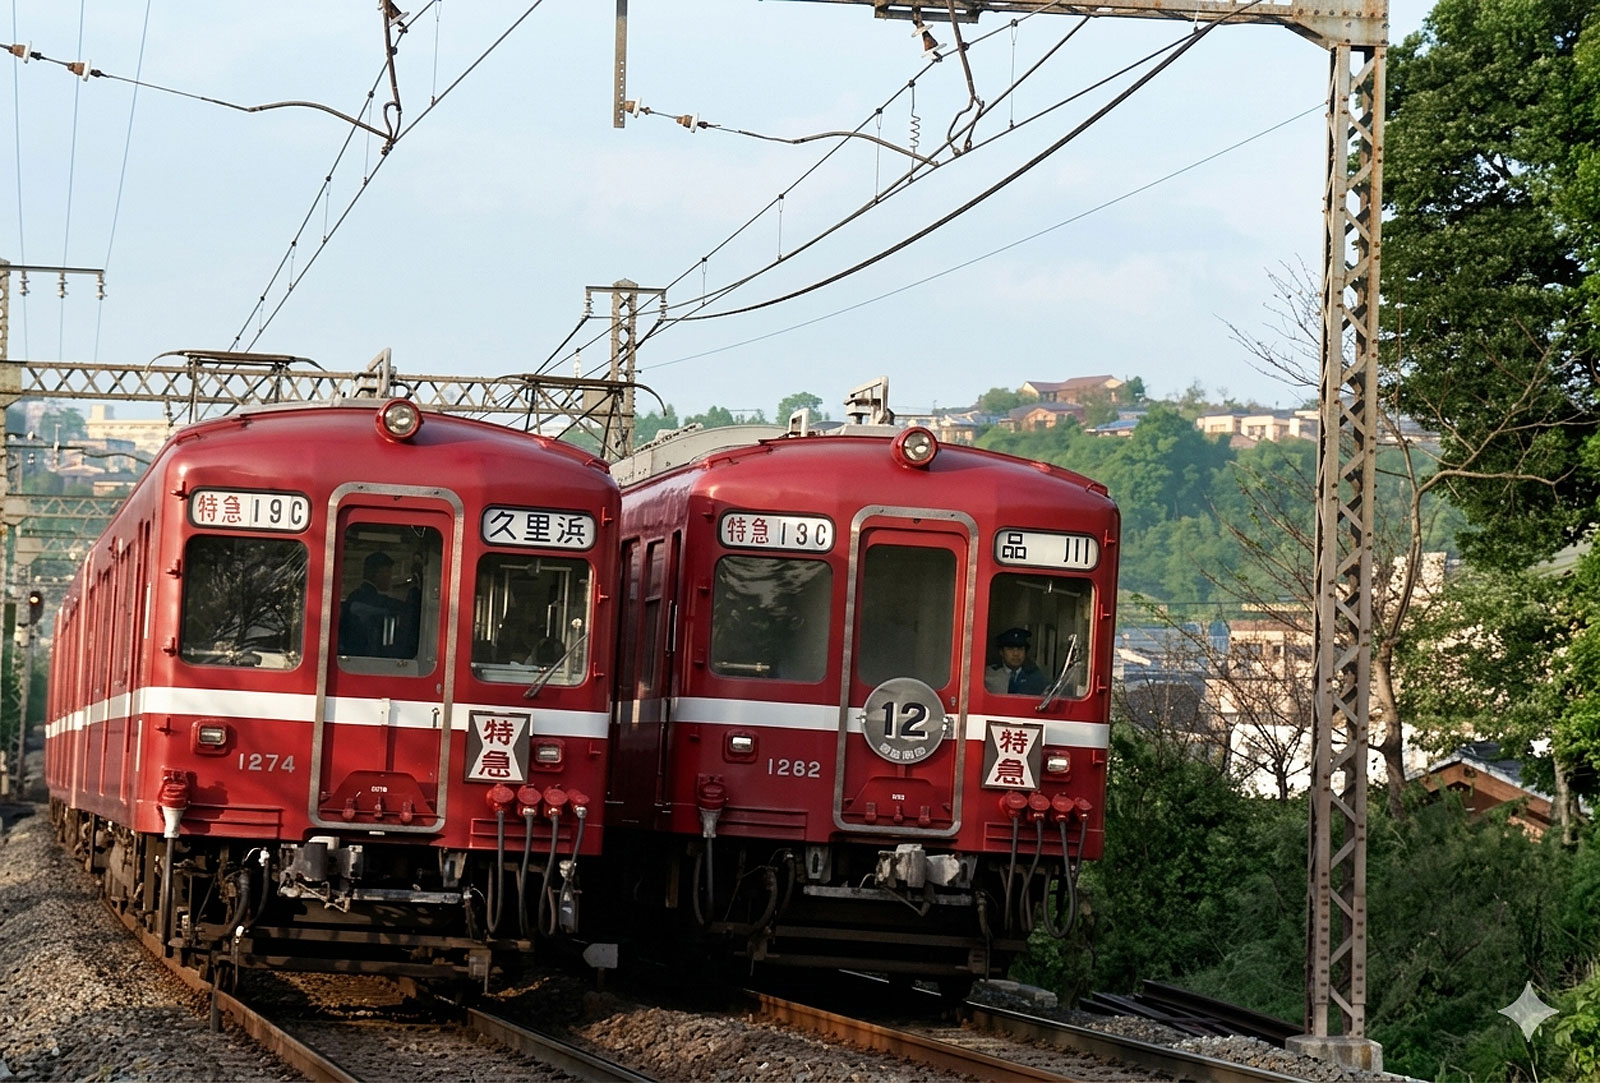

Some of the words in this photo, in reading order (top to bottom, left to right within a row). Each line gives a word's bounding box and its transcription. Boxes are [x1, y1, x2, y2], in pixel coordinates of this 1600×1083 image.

[198, 494, 242, 523] 特急
[254, 499, 302, 525] 19C
[490, 511, 585, 545] 久里浜
[727, 517, 769, 544] 特急
[781, 522, 826, 546] 13C
[882, 701, 929, 740] 12
[239, 753, 295, 773] 1274
[479, 719, 514, 778] 特急
[995, 729, 1028, 785] 特急
